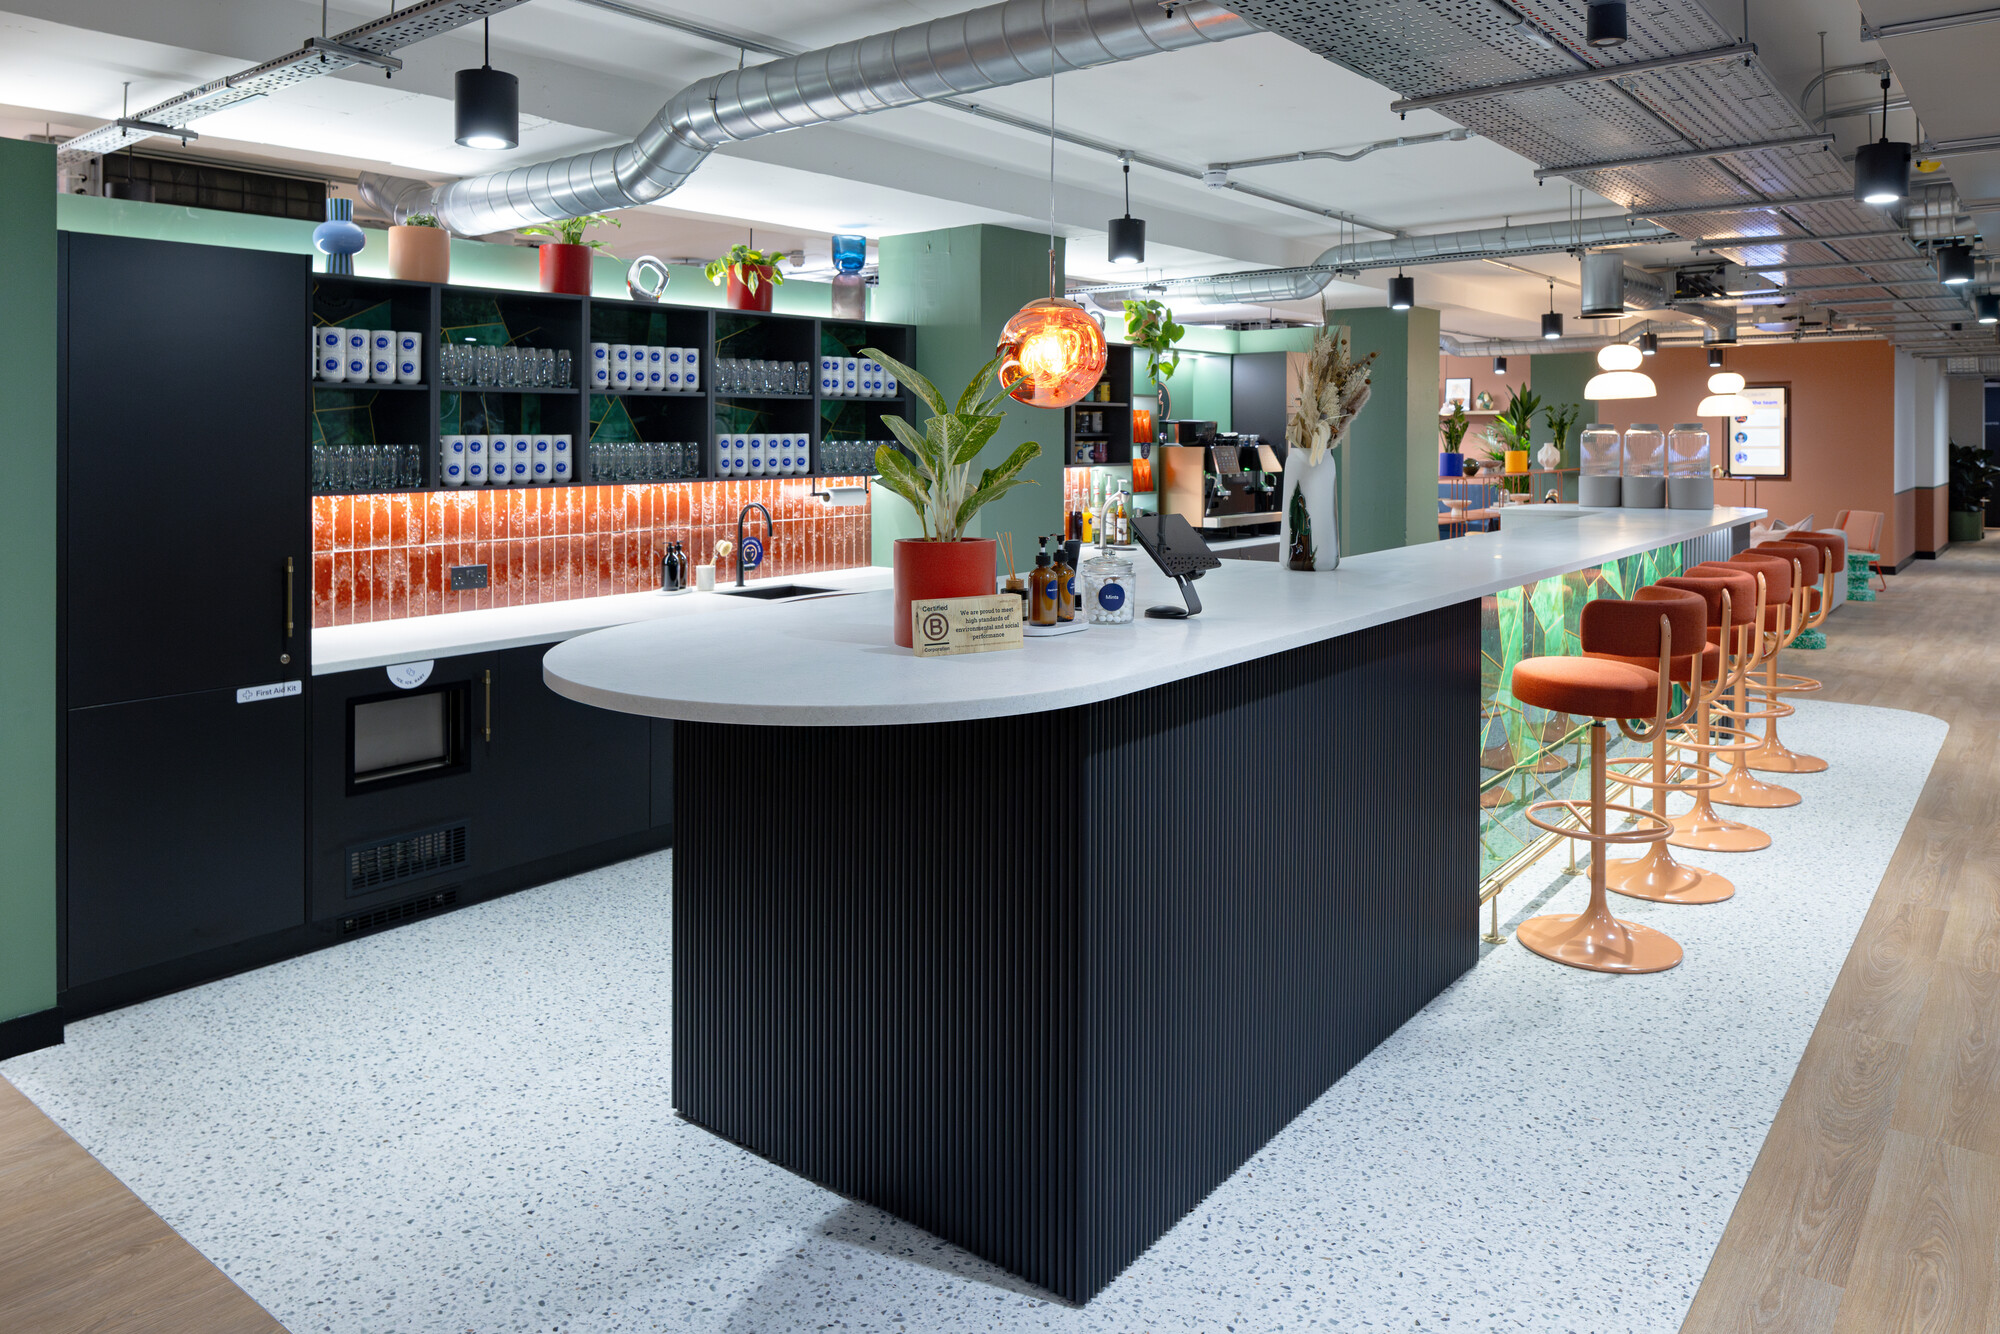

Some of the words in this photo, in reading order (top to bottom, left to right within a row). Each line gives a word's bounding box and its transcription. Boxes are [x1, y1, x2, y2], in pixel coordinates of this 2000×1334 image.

[922, 604, 948, 612] Certified
[979, 607, 995, 616] proud
[978, 615, 1003, 623] standards
[929, 618, 943, 636] B
[955, 624, 994, 633] environmental
[972, 632, 1005, 641] performance
[256, 689, 272, 697] First
